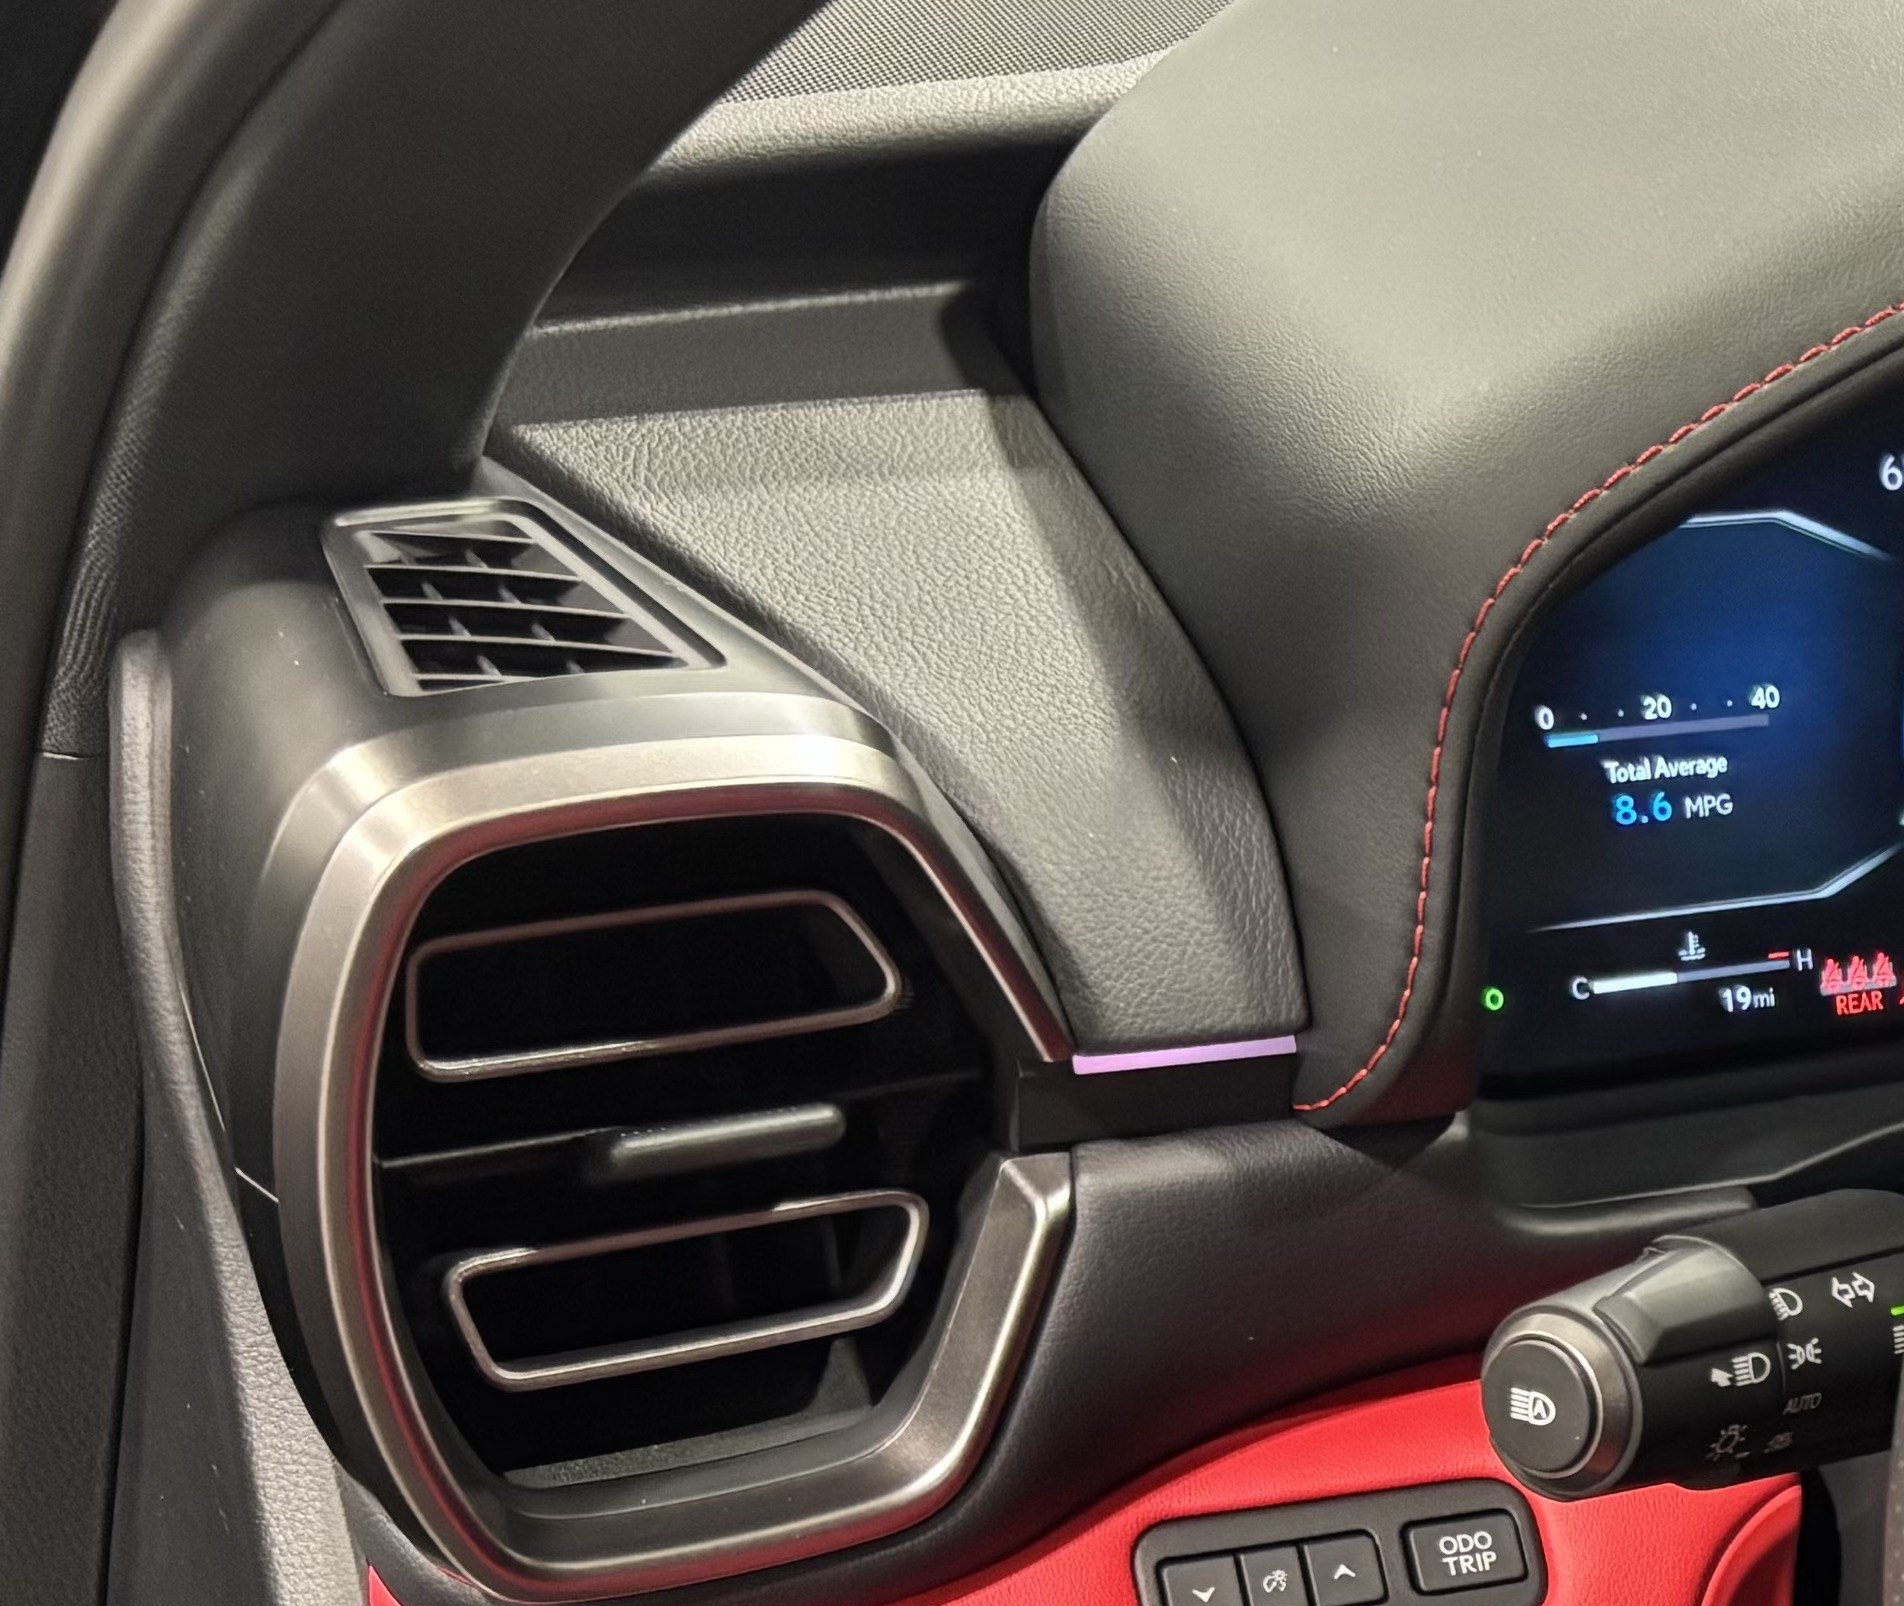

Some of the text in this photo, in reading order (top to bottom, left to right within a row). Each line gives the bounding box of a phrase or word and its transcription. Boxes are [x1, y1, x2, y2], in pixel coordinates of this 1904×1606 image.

[1535, 684, 1781, 732] 0 20 40
[1604, 752, 1729, 785] Total Average
[1613, 792, 1734, 826] 8.6 MPG
[1571, 948, 1813, 1001] C H
[1836, 991, 1883, 1015] REAR
[1783, 1393, 1822, 1416] AUTO
[1438, 1530, 1493, 1556] ODO
[1442, 1551, 1497, 1577] TRIP
